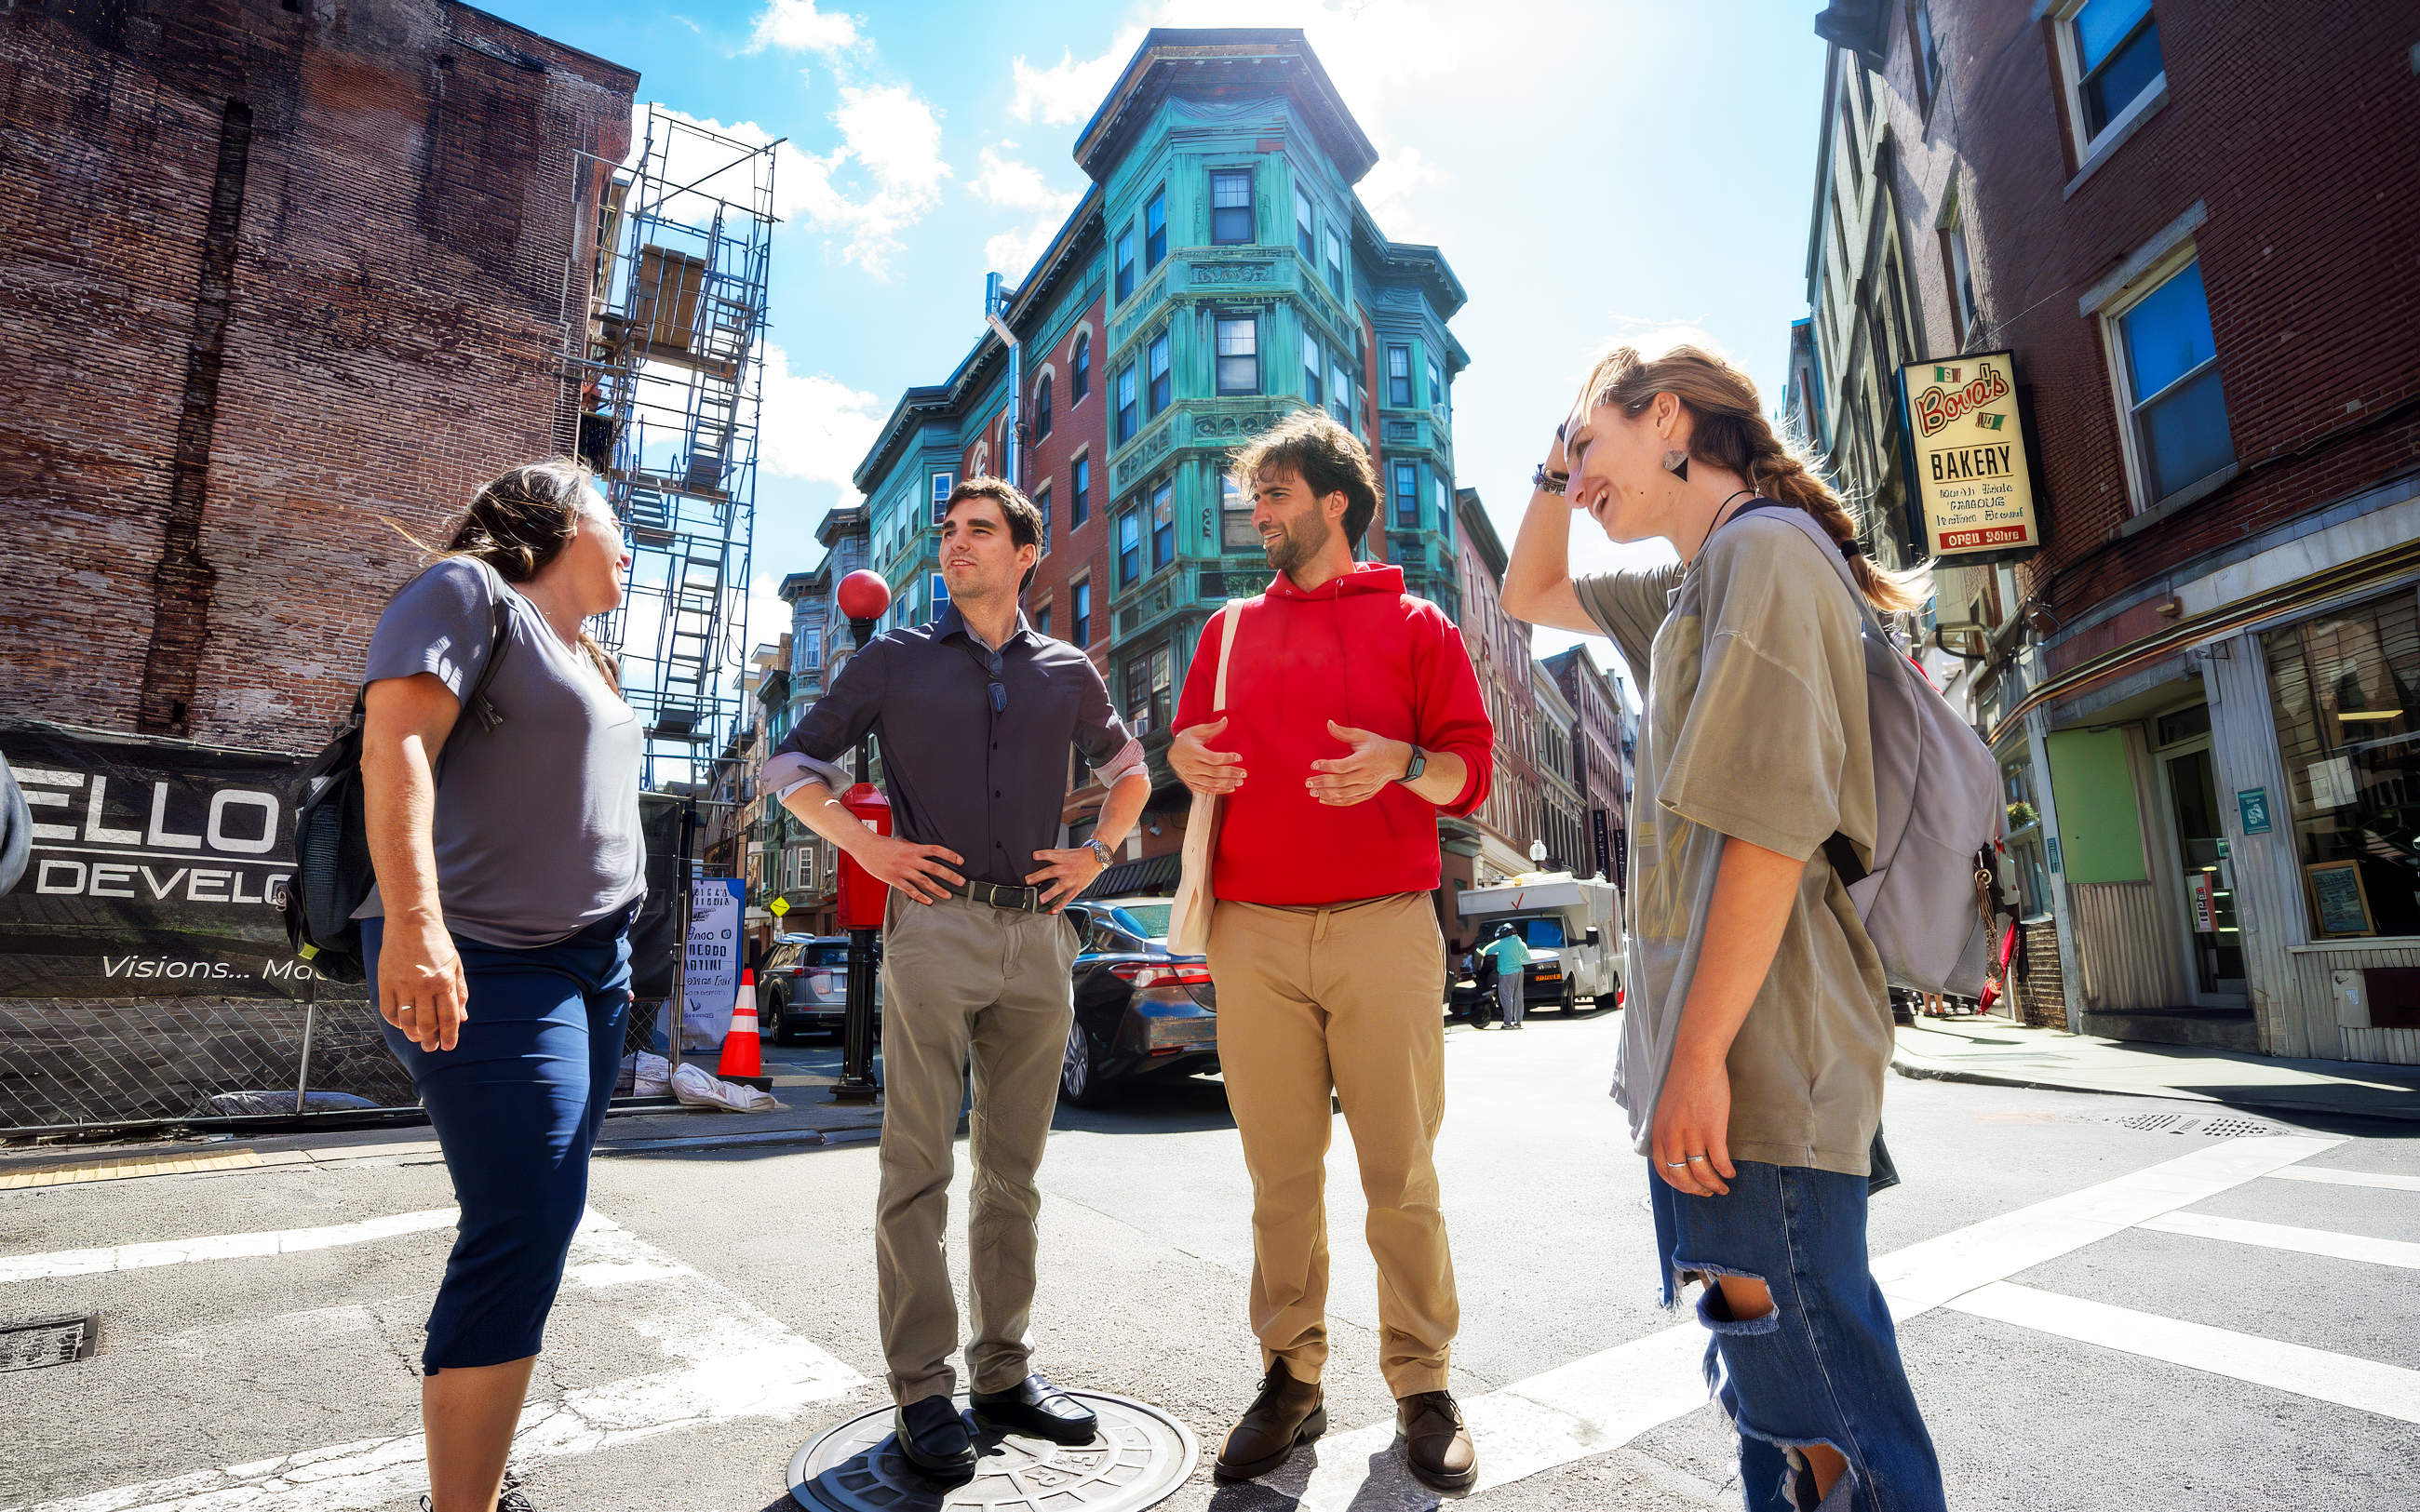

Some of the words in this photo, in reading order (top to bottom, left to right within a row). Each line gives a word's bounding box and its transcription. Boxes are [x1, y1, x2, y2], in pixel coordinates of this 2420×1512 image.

[1915, 363, 2010, 437] Bova's
[1930, 445, 2010, 481] BAKERY
[102, 955, 250, 979] Visions...
[262, 958, 329, 981] Ma
